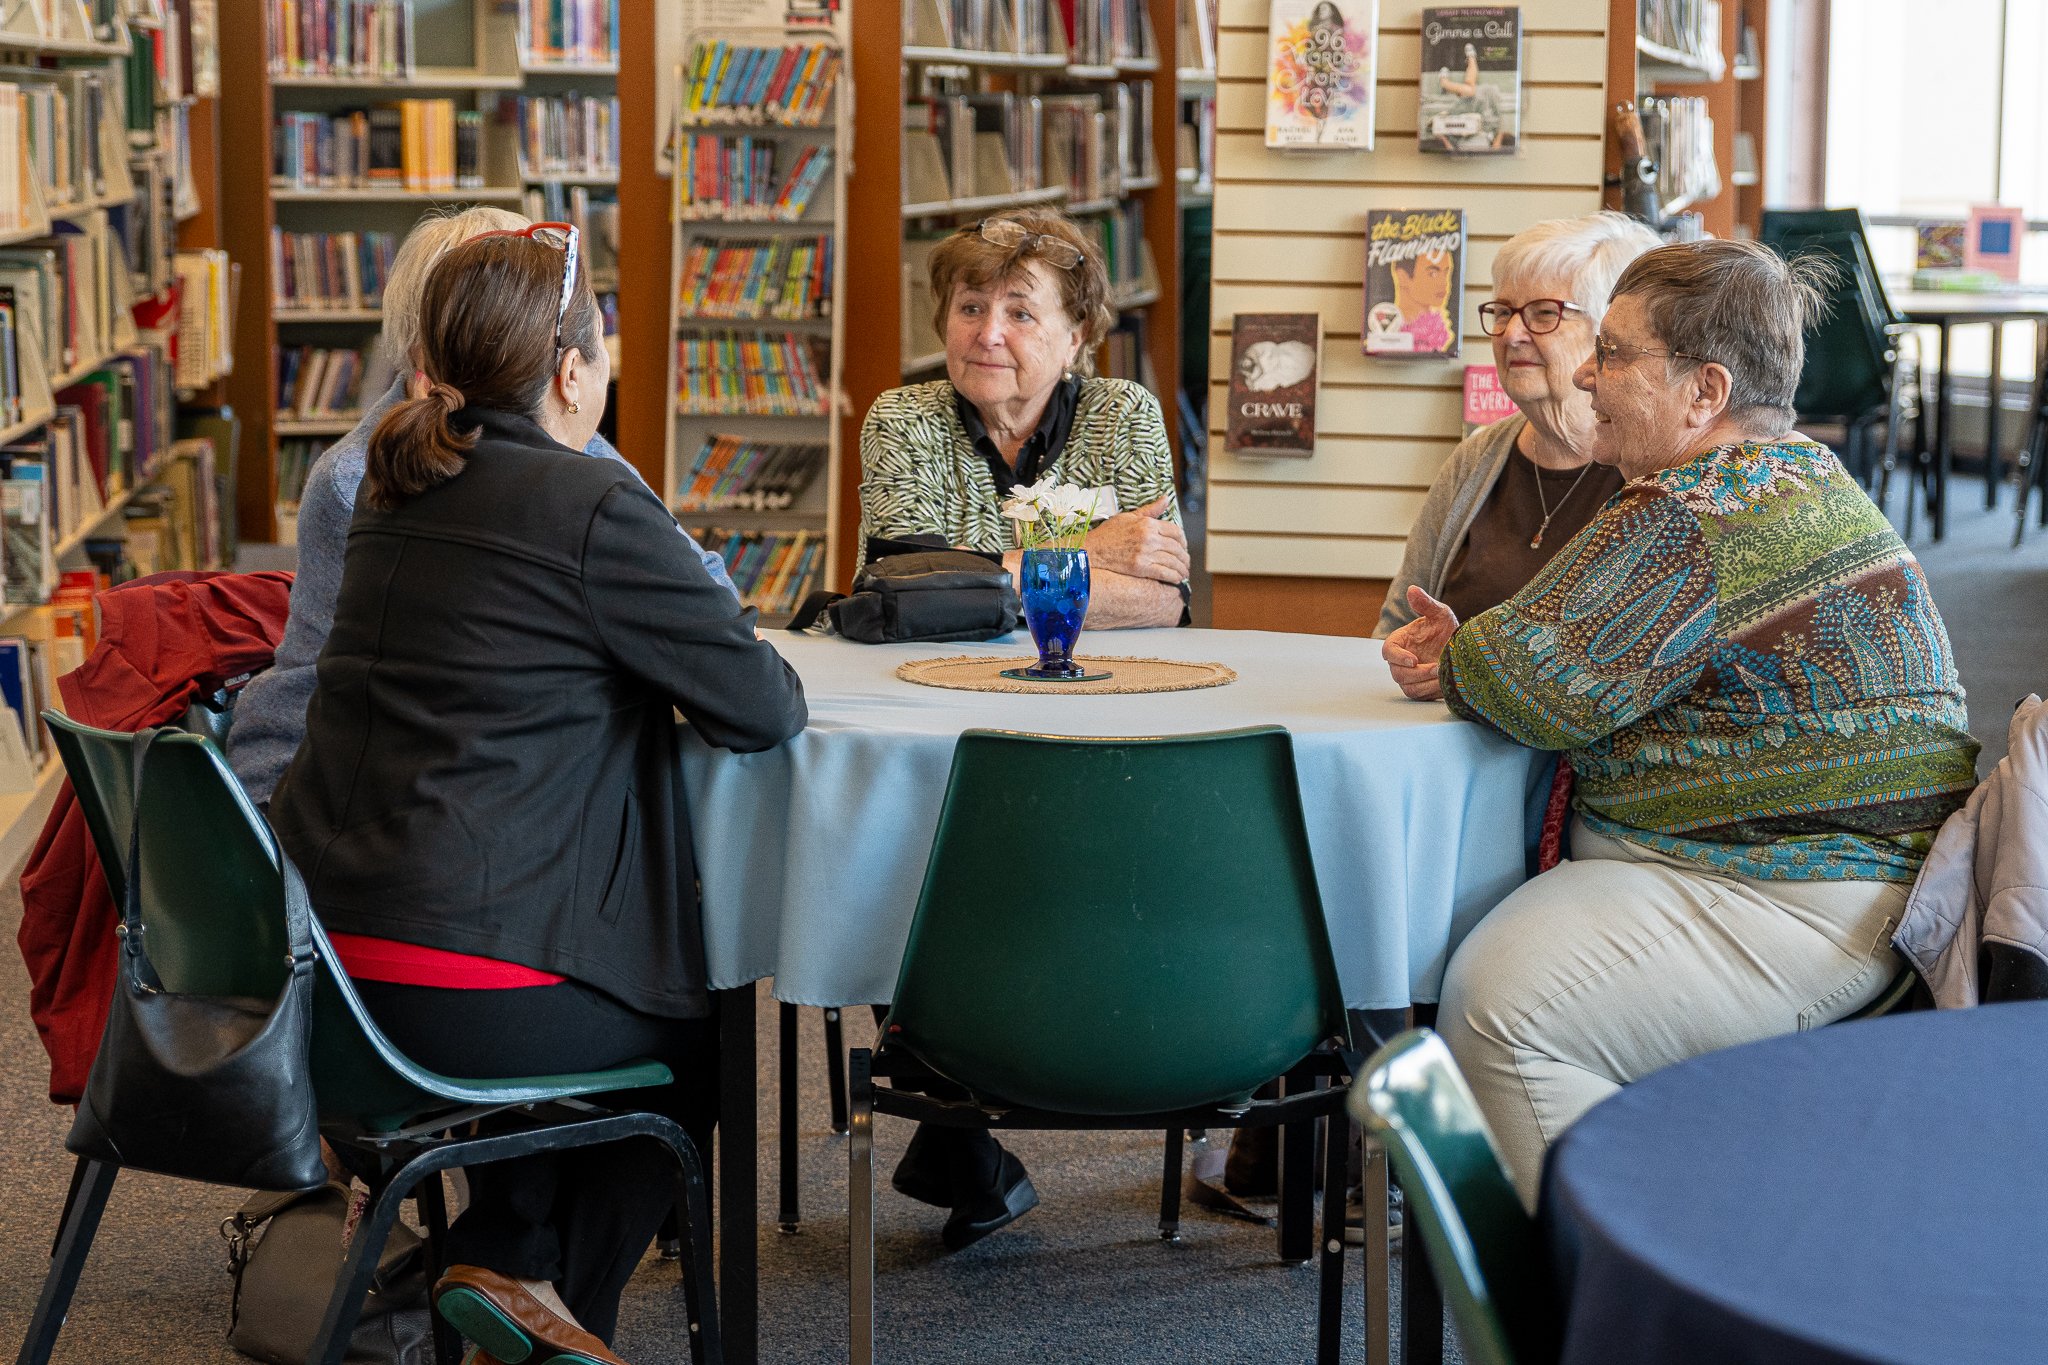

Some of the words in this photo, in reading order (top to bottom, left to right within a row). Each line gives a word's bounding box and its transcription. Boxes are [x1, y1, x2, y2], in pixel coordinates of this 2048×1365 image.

[1314, 28, 1346, 52] 96
[1425, 21, 1472, 45] Gimme
[1473, 28, 1482, 38] a
[1484, 20, 1513, 39] Call
[1371, 214, 1400, 240] the
[1400, 209, 1459, 240] Black
[1367, 232, 1460, 268] Flamingo
[1470, 373, 1493, 390] THE
[1241, 402, 1303, 418] CRAVE
